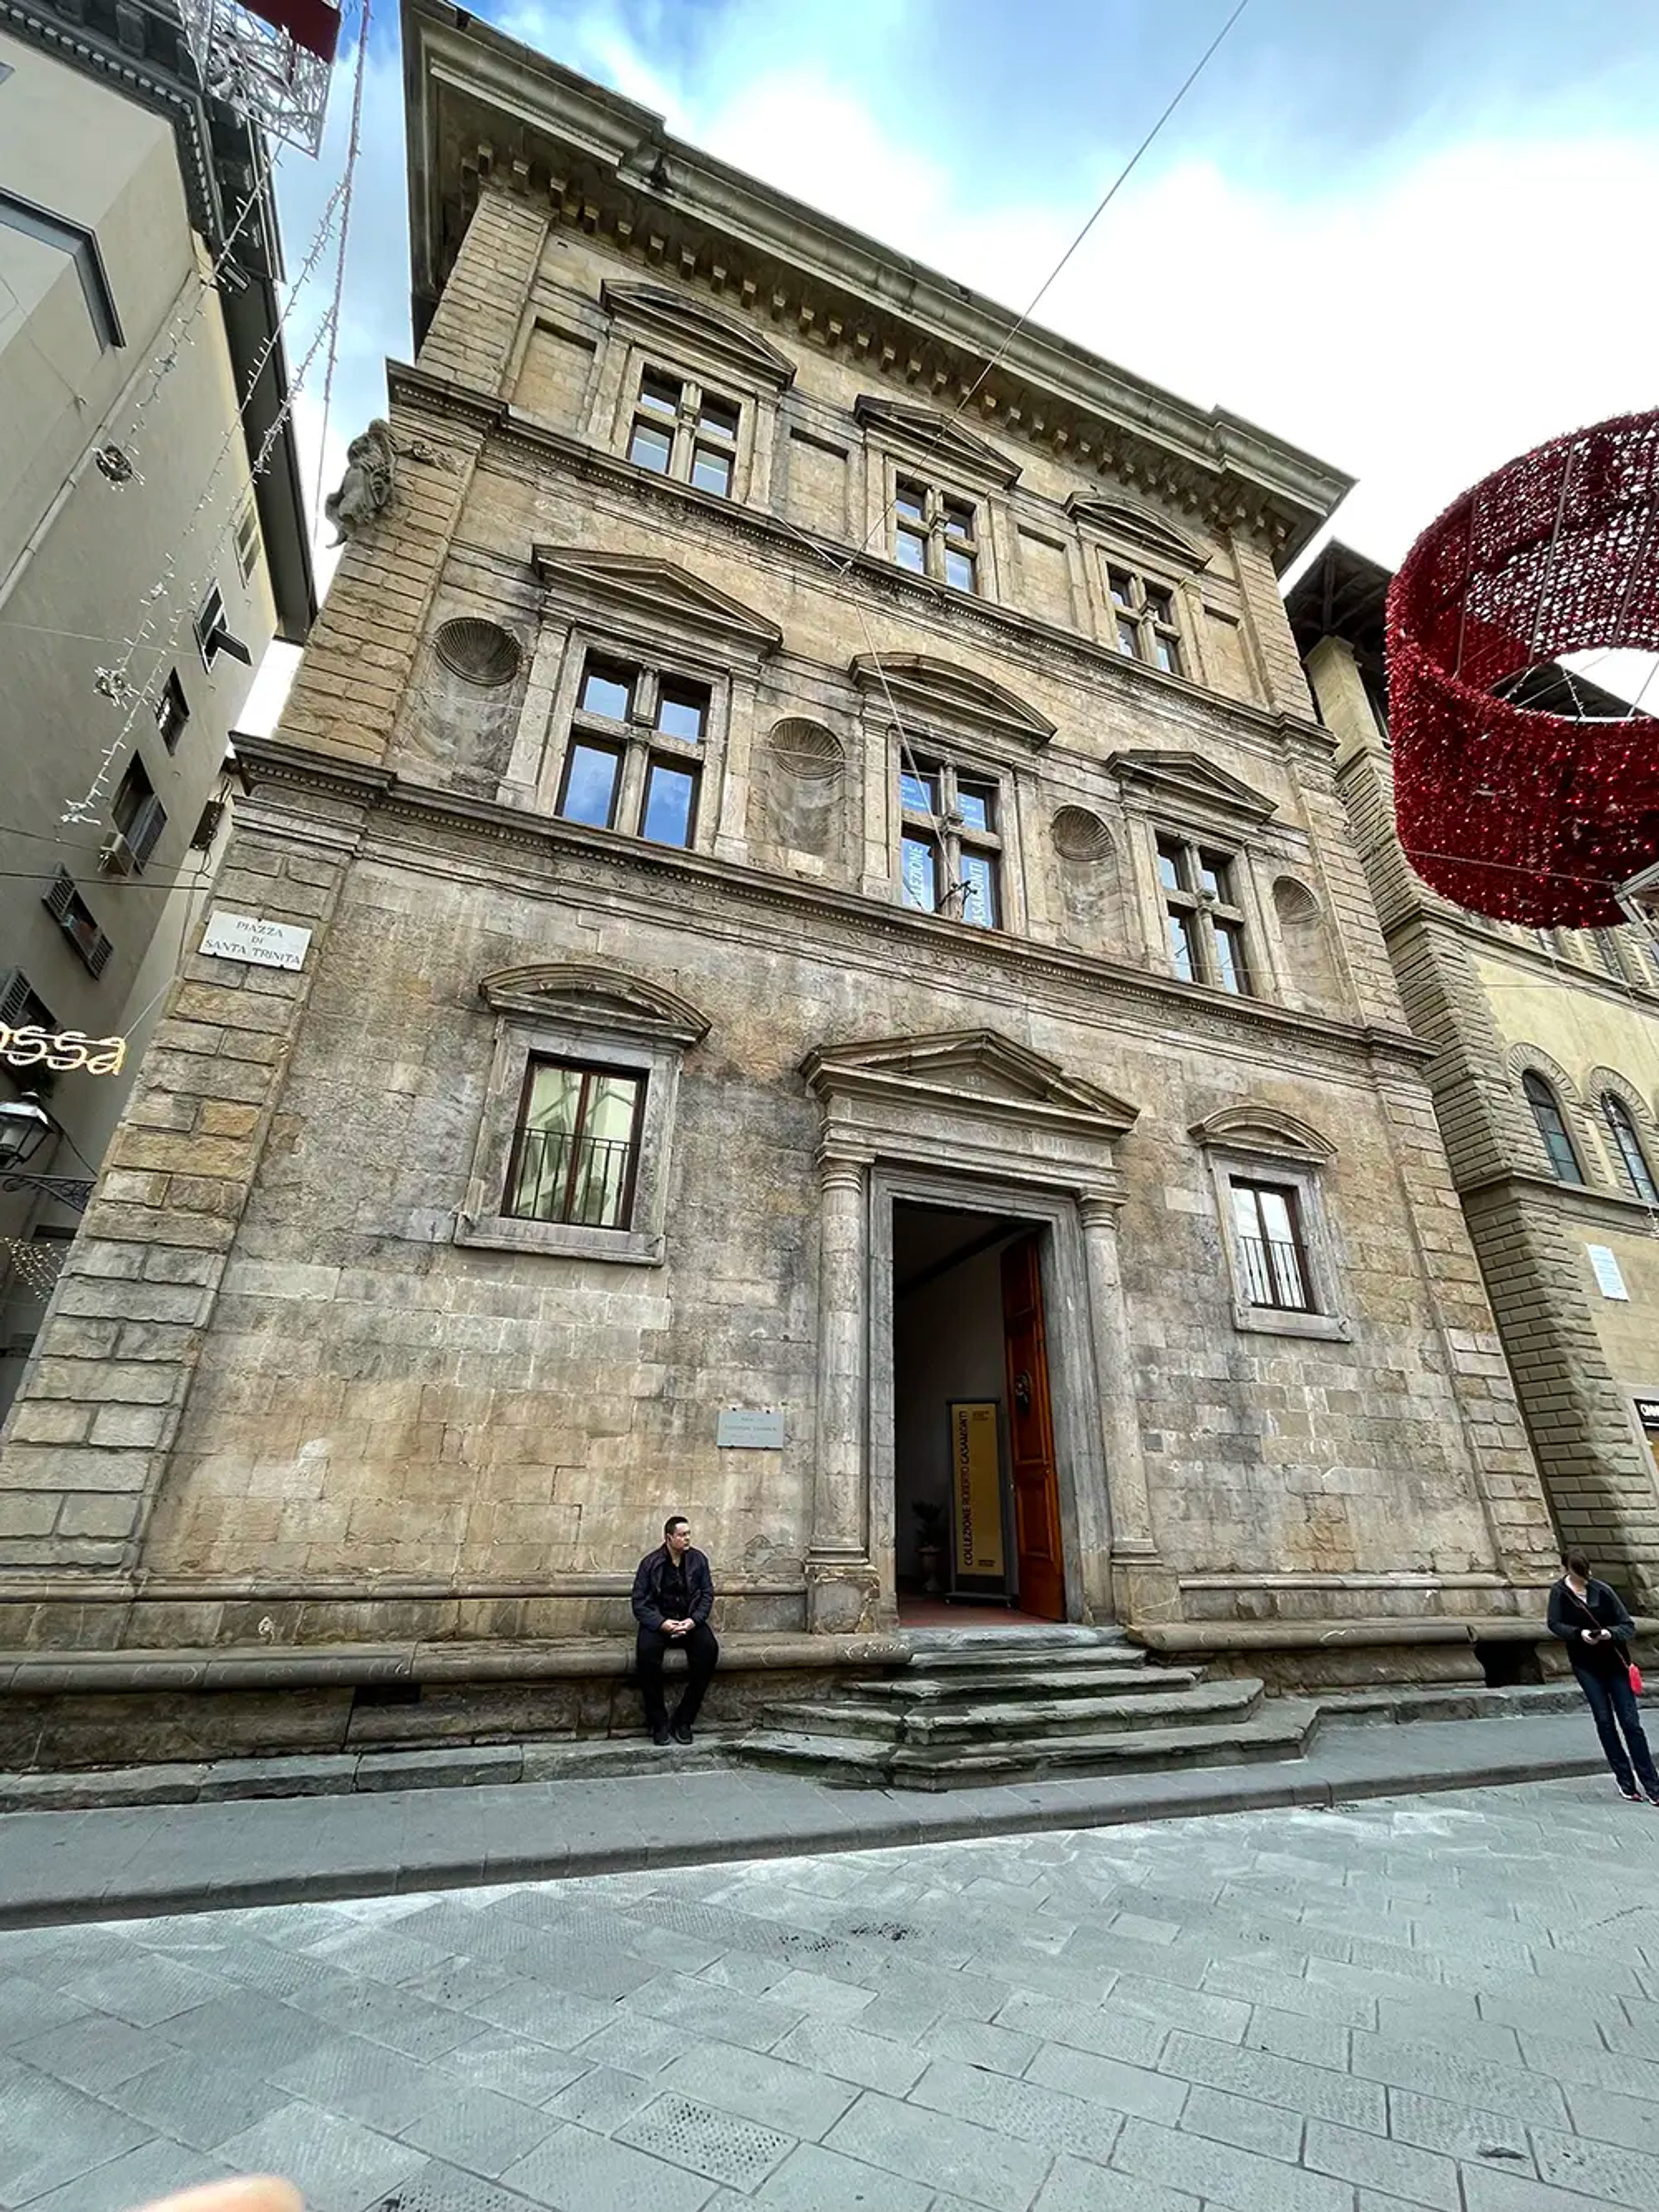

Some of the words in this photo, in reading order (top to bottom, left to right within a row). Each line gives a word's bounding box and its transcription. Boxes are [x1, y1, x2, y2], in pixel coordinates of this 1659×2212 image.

[236, 921, 283, 937] PIAZZA
[206, 939, 246, 954] SANTA
[252, 947, 300, 964] TRINITA
[962, 1507, 973, 1566] COLLEZIONE
